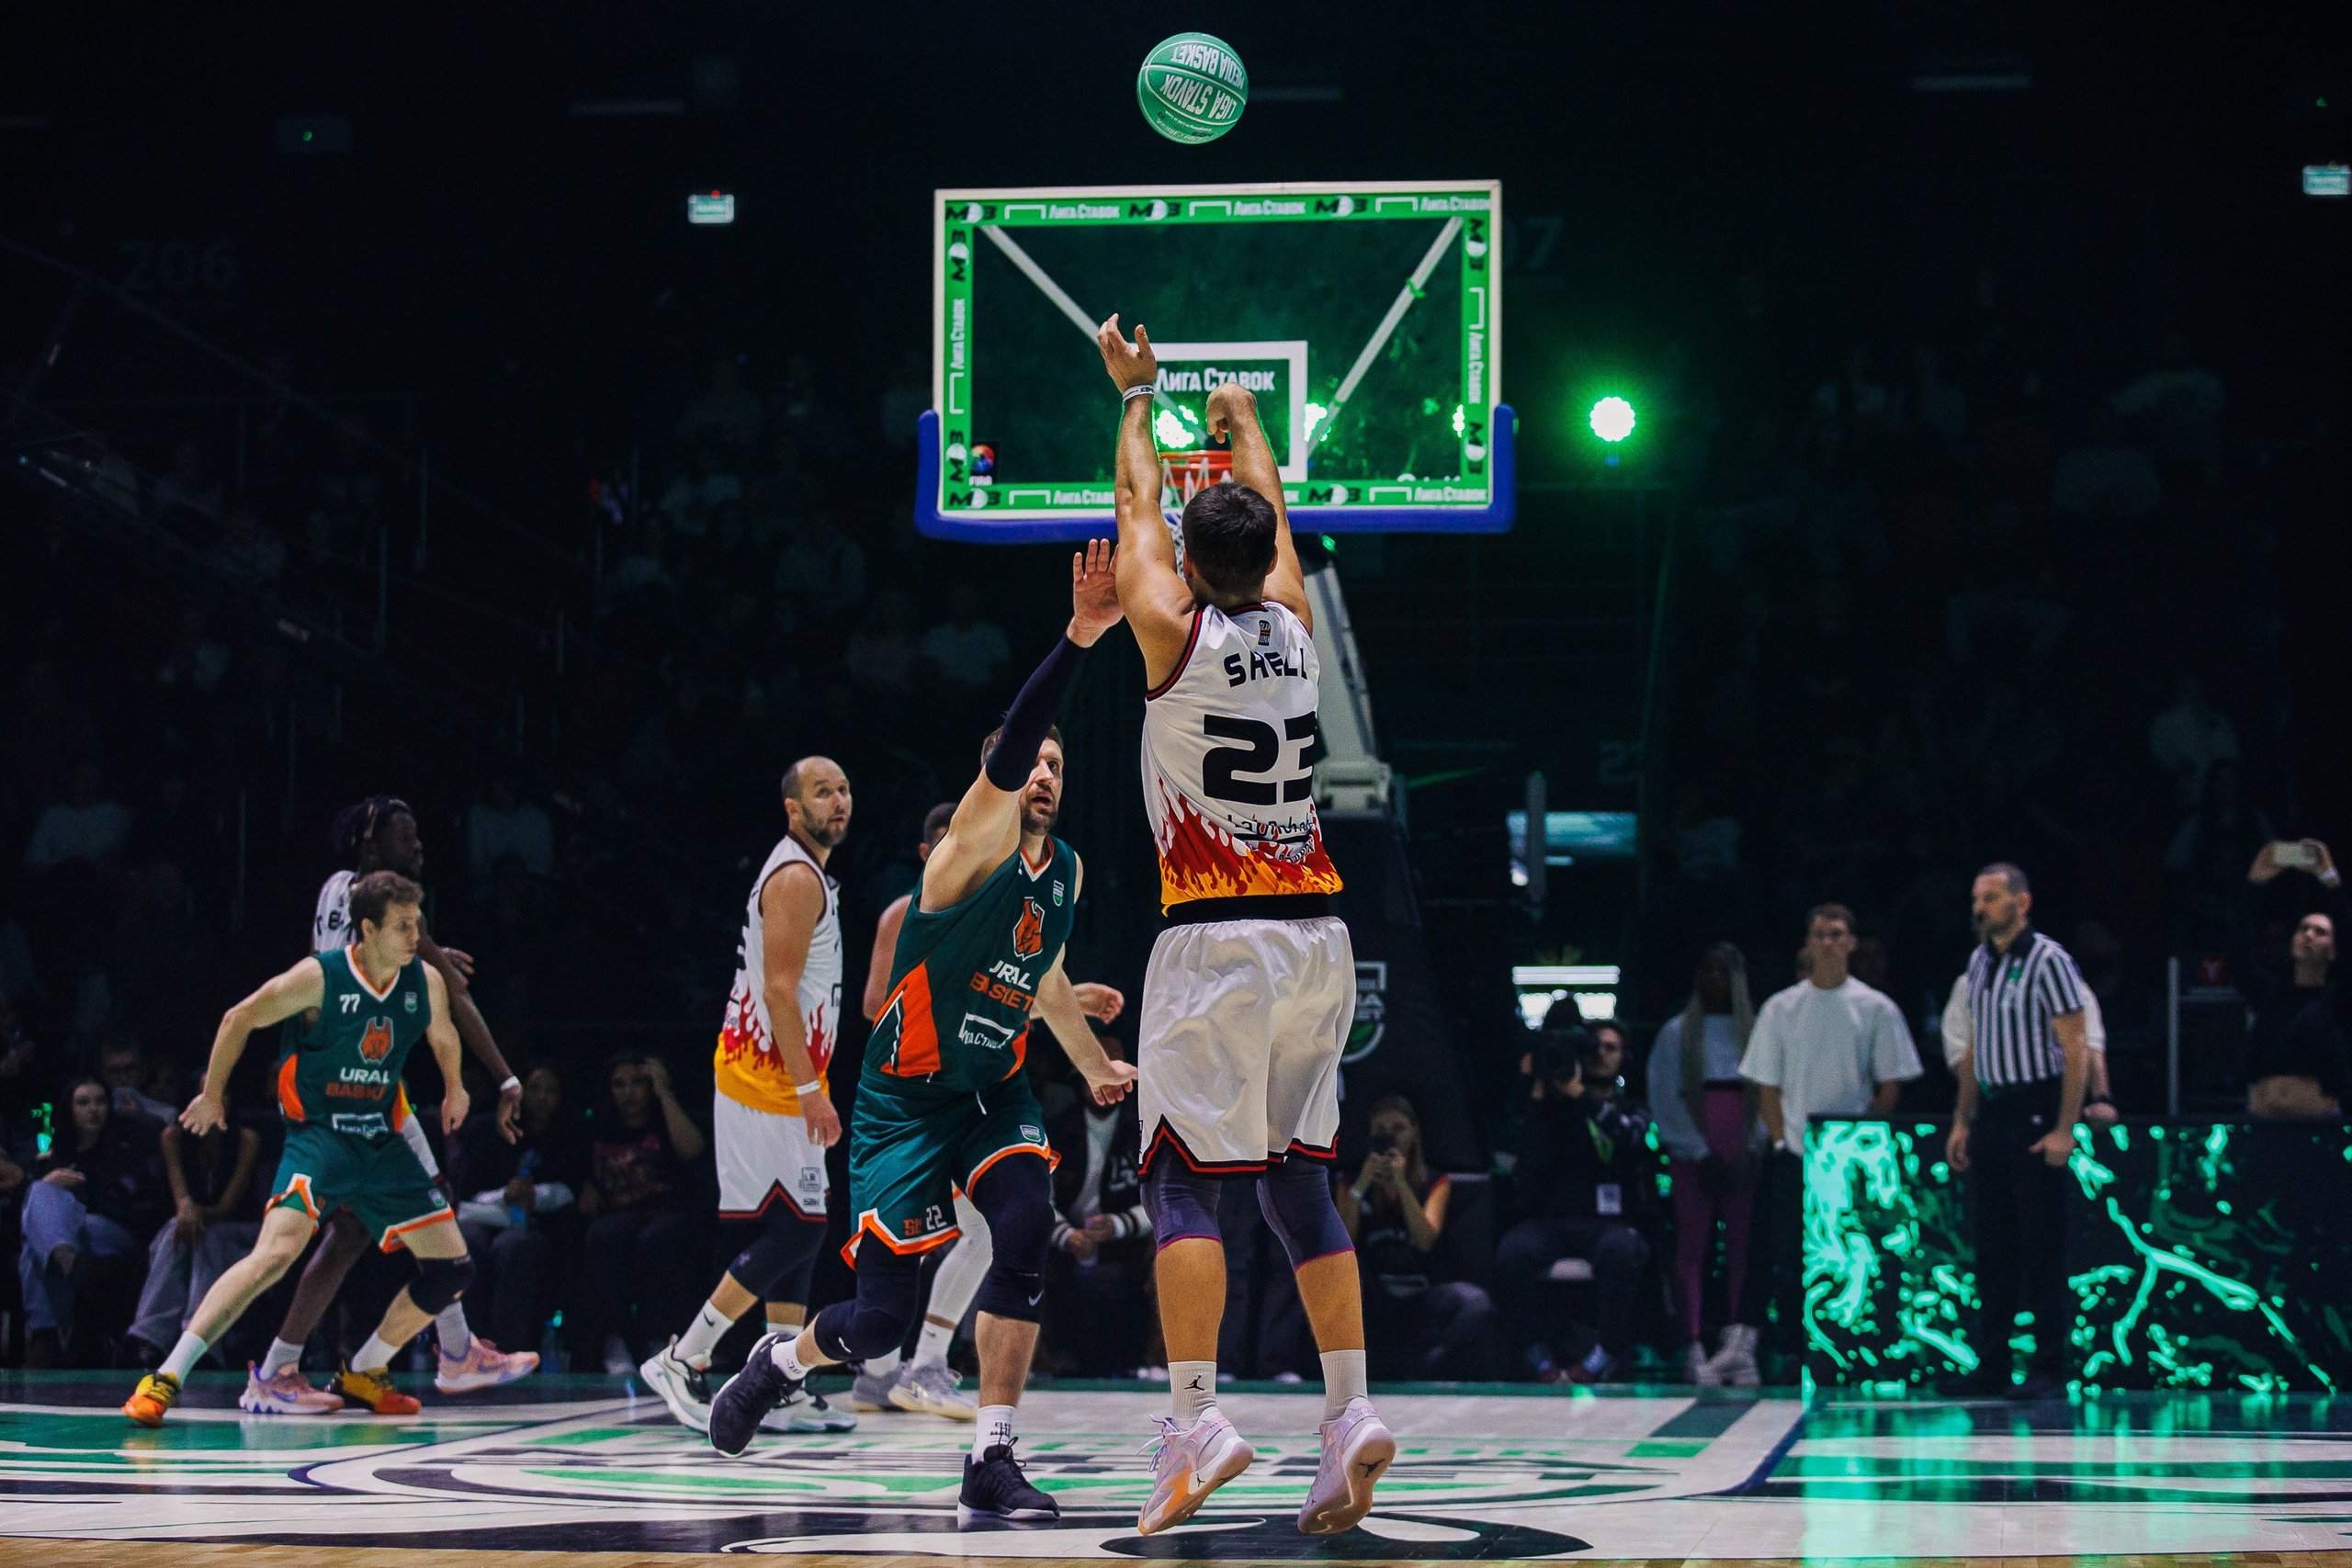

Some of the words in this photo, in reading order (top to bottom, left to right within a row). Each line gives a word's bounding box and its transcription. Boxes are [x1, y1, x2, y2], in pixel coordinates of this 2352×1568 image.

[1170, 44, 1219, 75] BASKET
[1219, 52, 1245, 89] MEDIA
[1159, 73, 1213, 115] STAVOK
[1207, 90, 1238, 120] LIGA
[1202, 710, 1317, 806] 23
[340, 994, 361, 1014] 77
[926, 1204, 947, 1231] 22
